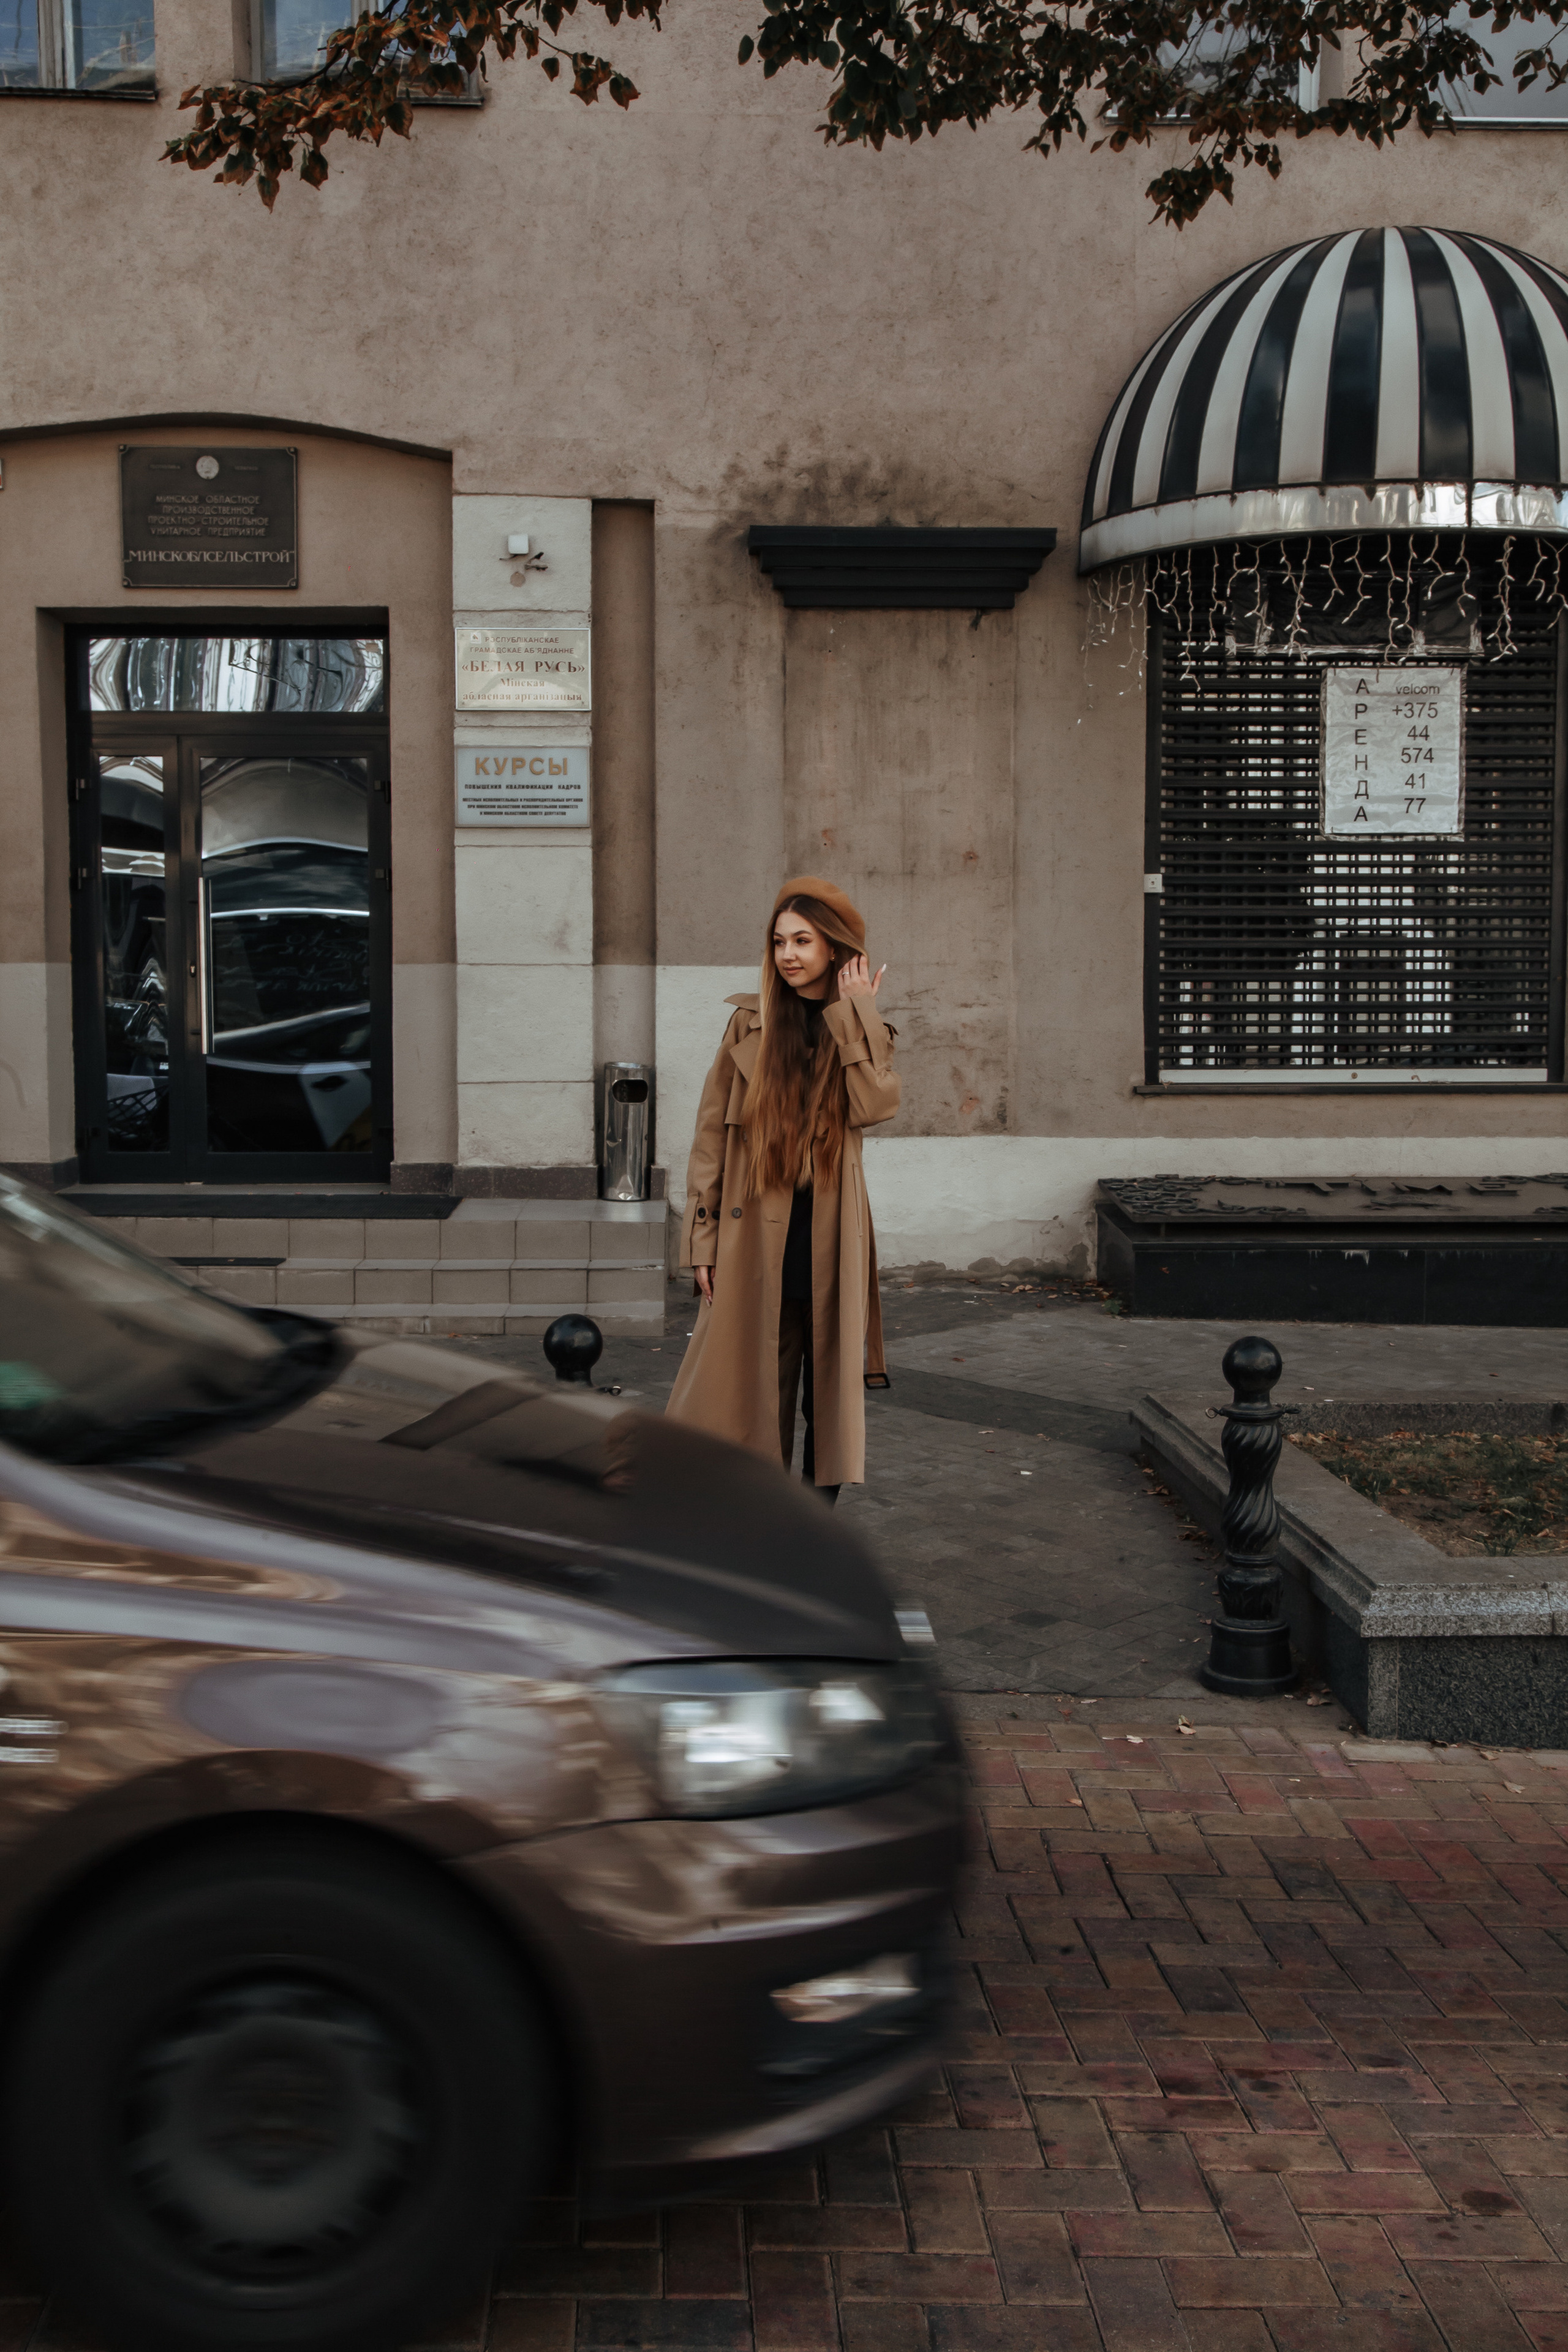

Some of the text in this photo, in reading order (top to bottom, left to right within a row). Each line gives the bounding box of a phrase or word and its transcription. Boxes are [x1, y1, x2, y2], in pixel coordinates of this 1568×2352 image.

[156, 495, 260, 504] МИНСКОЕ ОБЛАСТНОЕ
[162, 505, 255, 515] ПРОИЗВОДСТВЕННОЕ
[151, 527, 266, 537] УНИТАРНОЕ ПРЕДПРИЯТИЕ
[462, 661, 585, 673] «БЕЛАЯ РУСЬ»
[500, 678, 545, 687] Мінская
[1396, 684, 1439, 695] velcom
[1392, 703, 1438, 718] +375
[1408, 726, 1430, 741] 44
[1354, 678, 1370, 822] АРЕНДА
[1401, 748, 1434, 763] 574
[475, 758, 568, 775] КУРСЫ
[1405, 773, 1425, 789] 41
[1404, 798, 1426, 813] 77
